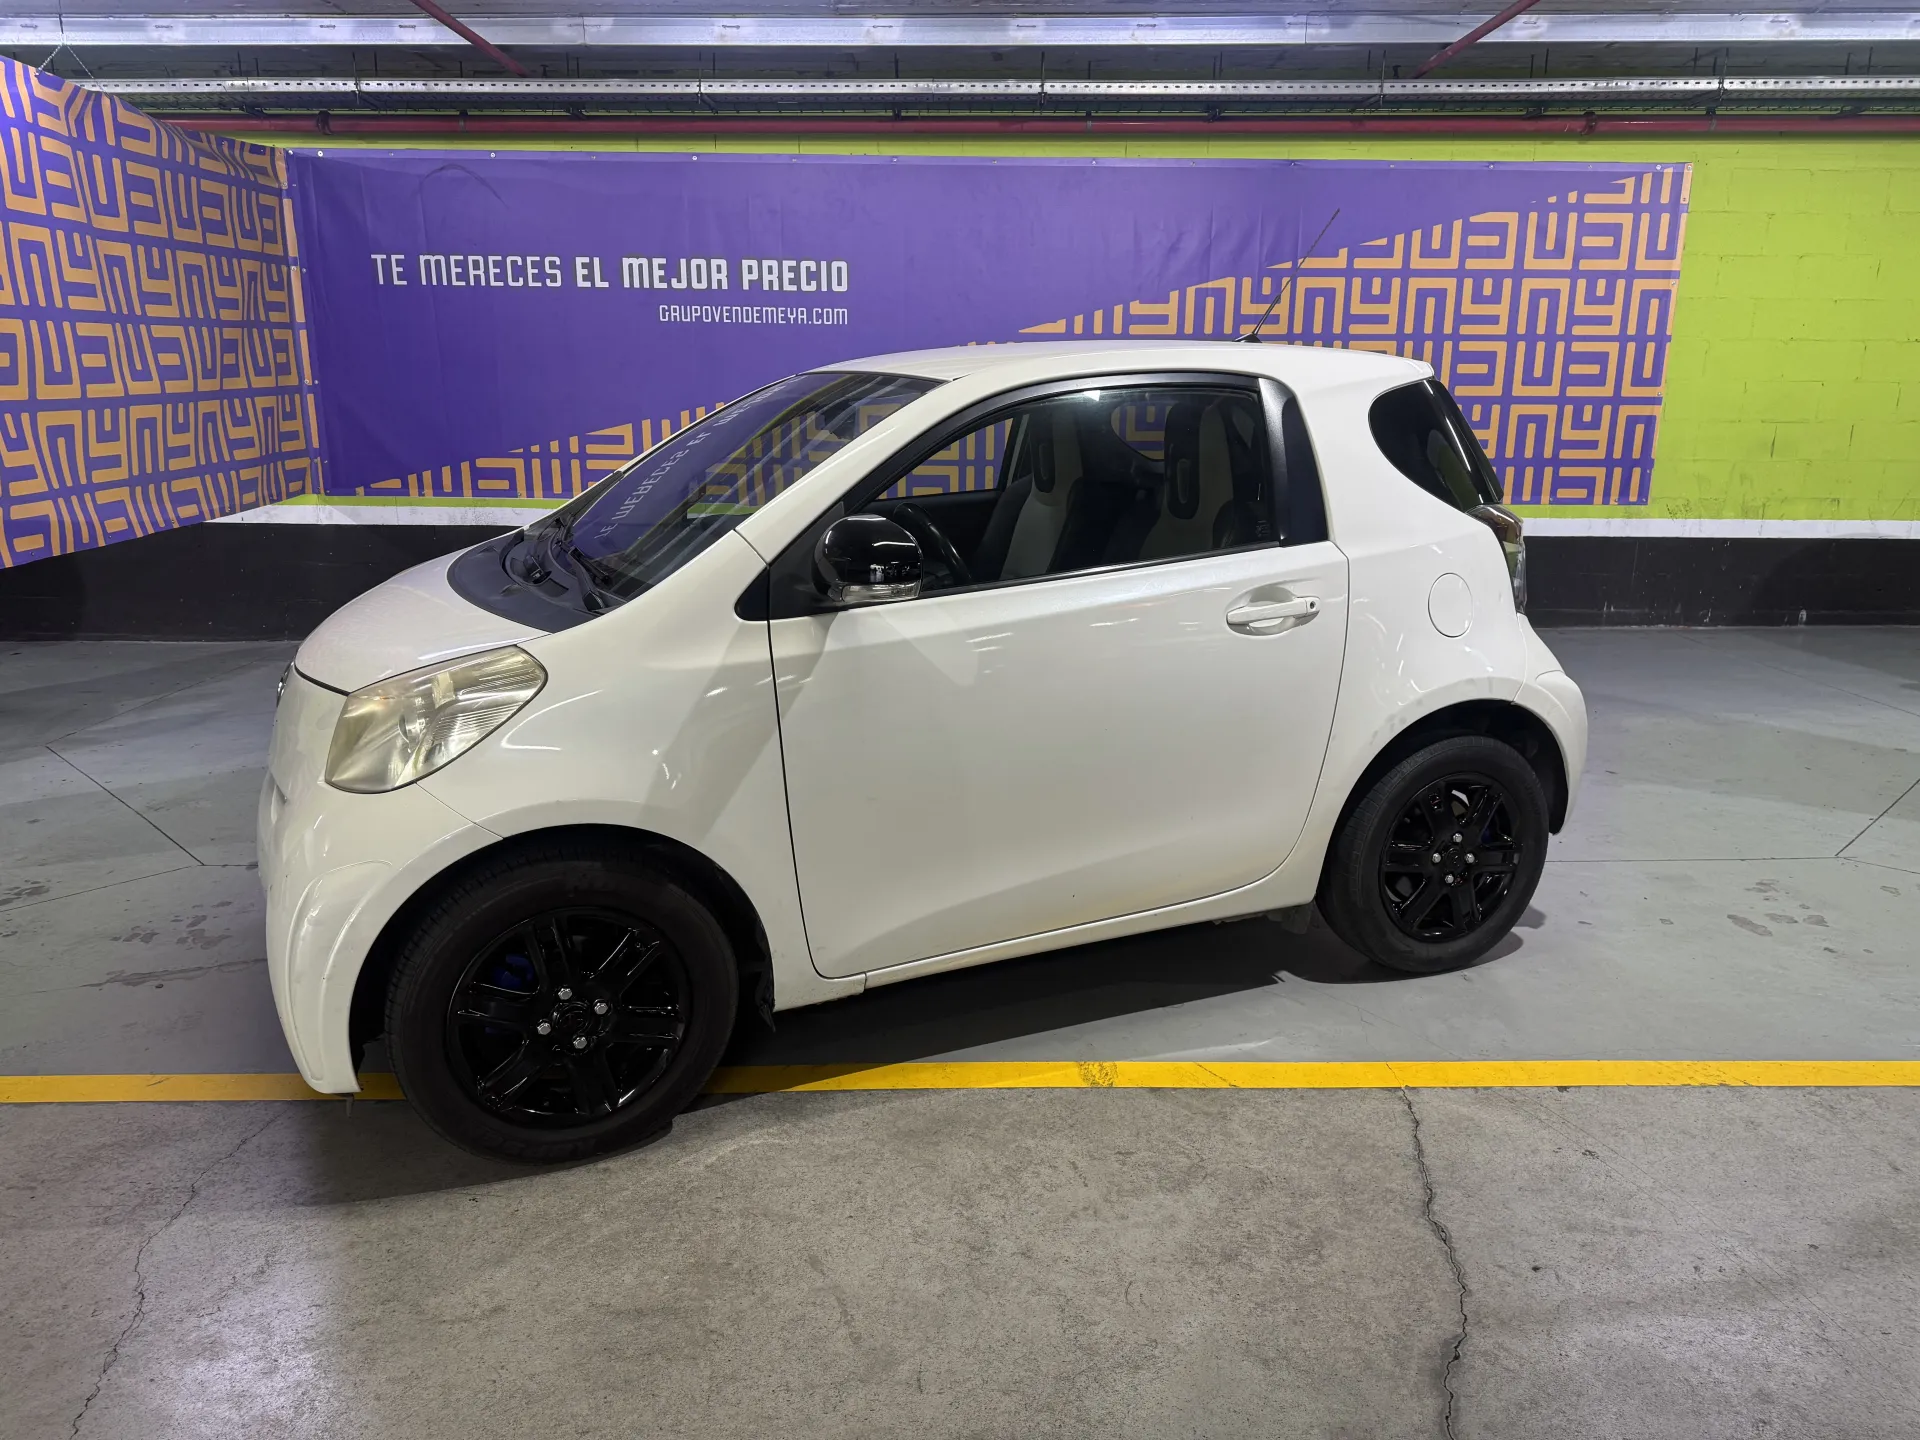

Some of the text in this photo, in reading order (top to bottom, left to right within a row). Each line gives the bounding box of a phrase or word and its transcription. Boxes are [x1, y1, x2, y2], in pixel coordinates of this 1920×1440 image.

[371, 254, 848, 293] TE MERECES EL MEJOR PRECIO
[659, 304, 848, 325] GRUPOVENDEMEYA.COM
